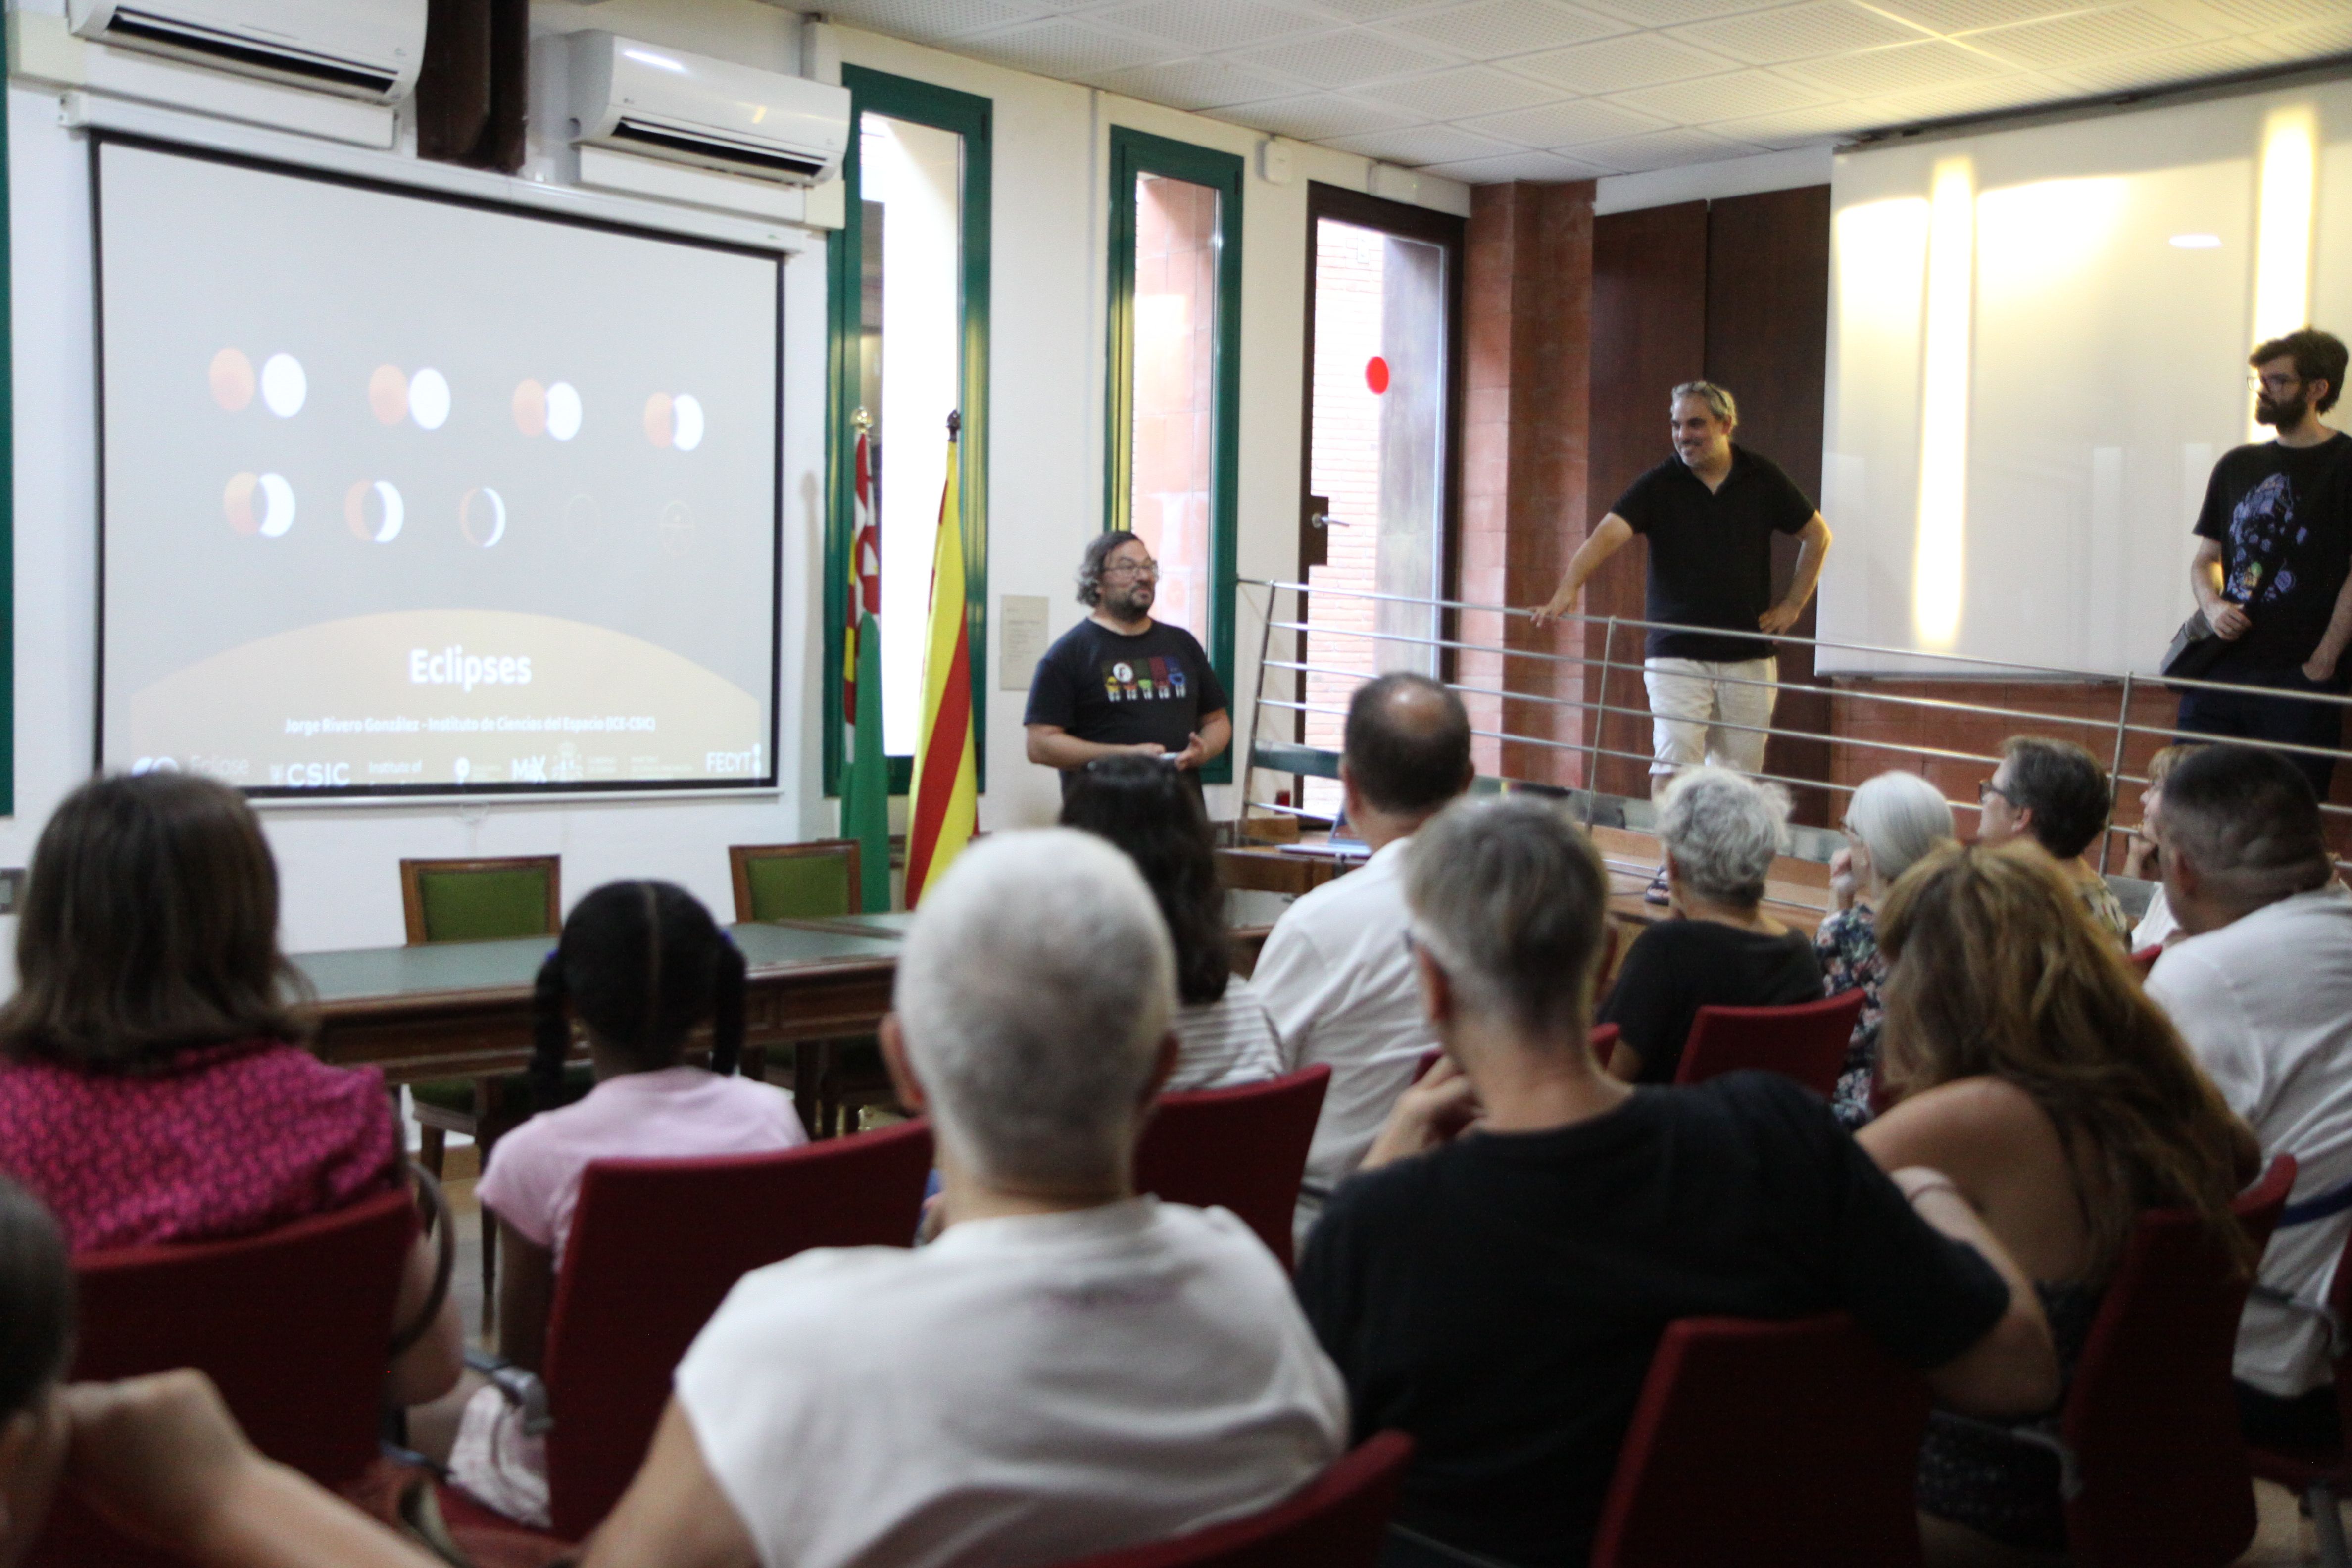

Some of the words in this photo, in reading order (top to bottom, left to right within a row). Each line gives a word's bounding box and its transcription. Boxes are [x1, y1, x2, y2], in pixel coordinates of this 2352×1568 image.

[409, 645, 532, 693] Eclipses
[286, 719, 320, 735] Jorge
[322, 717, 362, 732] Rivero
[428, 716, 478, 732] Instituto
[480, 716, 495, 731] de
[496, 716, 543, 731] Ciencias
[544, 716, 562, 731] del
[563, 716, 604, 733] Espacio
[706, 751, 751, 773] FECYT
[286, 762, 350, 786] CSIC
